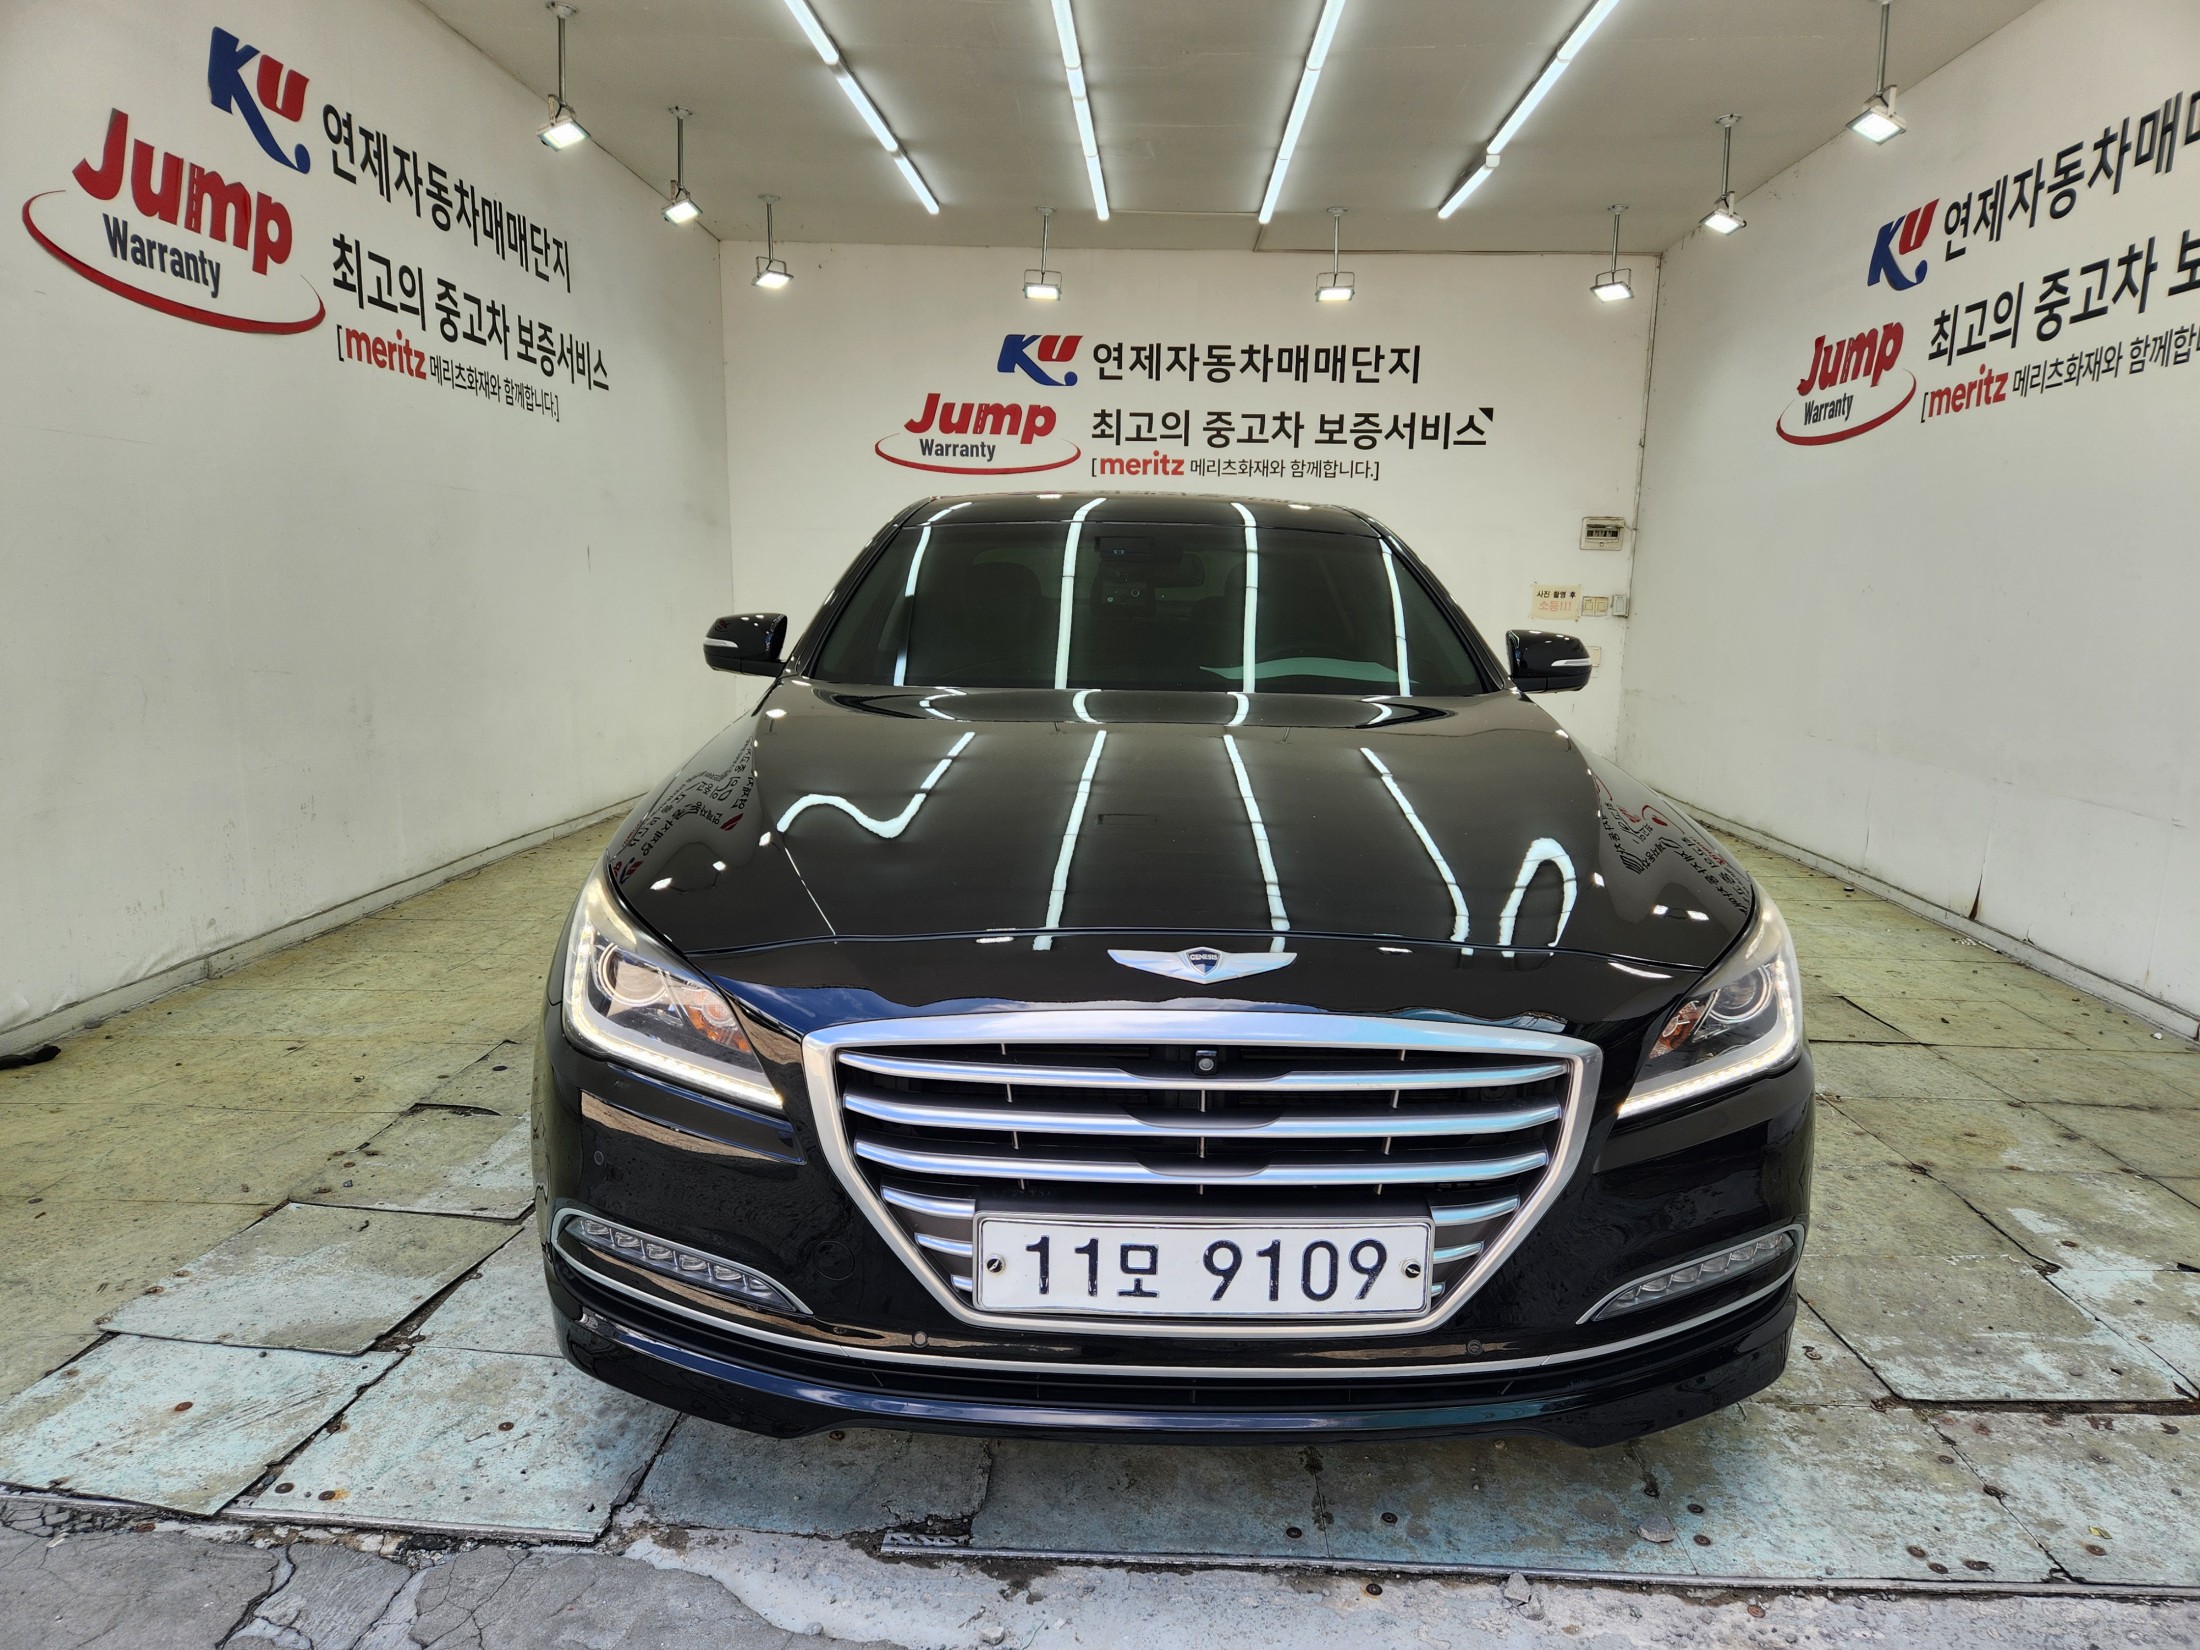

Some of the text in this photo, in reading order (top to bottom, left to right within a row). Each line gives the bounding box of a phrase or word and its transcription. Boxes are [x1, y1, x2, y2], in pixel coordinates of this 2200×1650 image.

[72, 107, 293, 276] Jump
[322, 103, 571, 293] 연제자동차매매단지
[1944, 90, 2200, 262] 연제자동차매
[102, 212, 221, 299] Warranty
[332, 233, 609, 391] 최고의 중고차 보증서비스
[1928, 281, 2025, 366] 최고의
[2034, 236, 2158, 342] 중고차
[429, 355, 502, 402] 메리츠화재와
[1093, 342, 1420, 384] 연제자동차매매단지
[1797, 321, 1904, 396] Jump
[2012, 341, 2123, 397] 메리츠화재와
[2129, 323, 2200, 374] 함께합
[904, 393, 1057, 445] Jump
[1091, 409, 1487, 450] 최고의 중고차 보증서비스
[1804, 392, 1854, 426] Warranty
[919, 439, 996, 462] Warranty
[1190, 458, 1286, 478] 메리츠화재와
[1536, 590, 1551, 598] 사진
[1569, 591, 1577, 599] 후
[1189, 953, 1219, 961] GENESIS
[1025, 1234, 1388, 1302] 11모 9109
